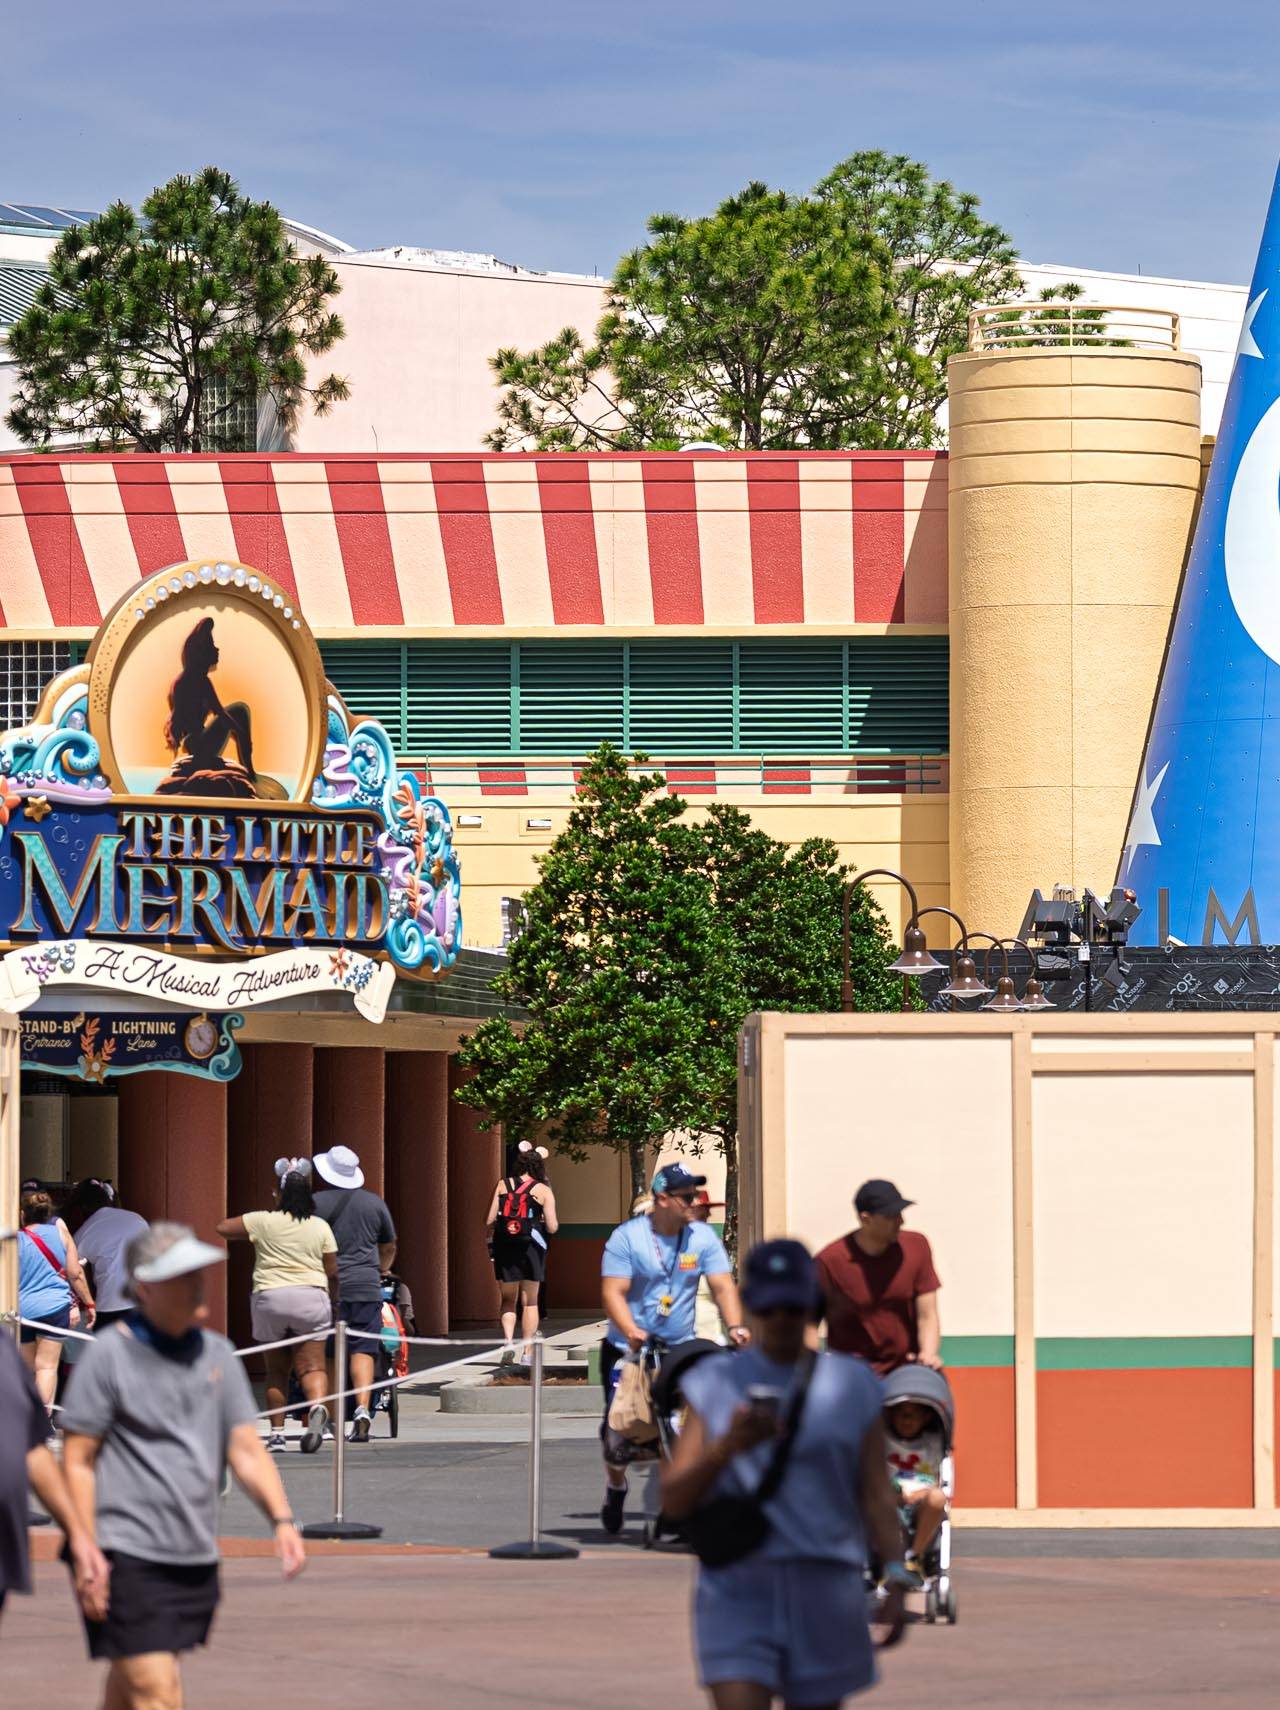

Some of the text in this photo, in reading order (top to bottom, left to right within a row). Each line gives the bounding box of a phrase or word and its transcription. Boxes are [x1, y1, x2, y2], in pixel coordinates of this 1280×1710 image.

[120, 811, 377, 866] THE LITTLE
[9, 831, 390, 952] MERMAID
[84, 947, 320, 1005] A Musical Adventure
[18, 1019, 176, 1035] STAND-BY LIGHTNING
[21, 1034, 157, 1051] Entrance Lane
